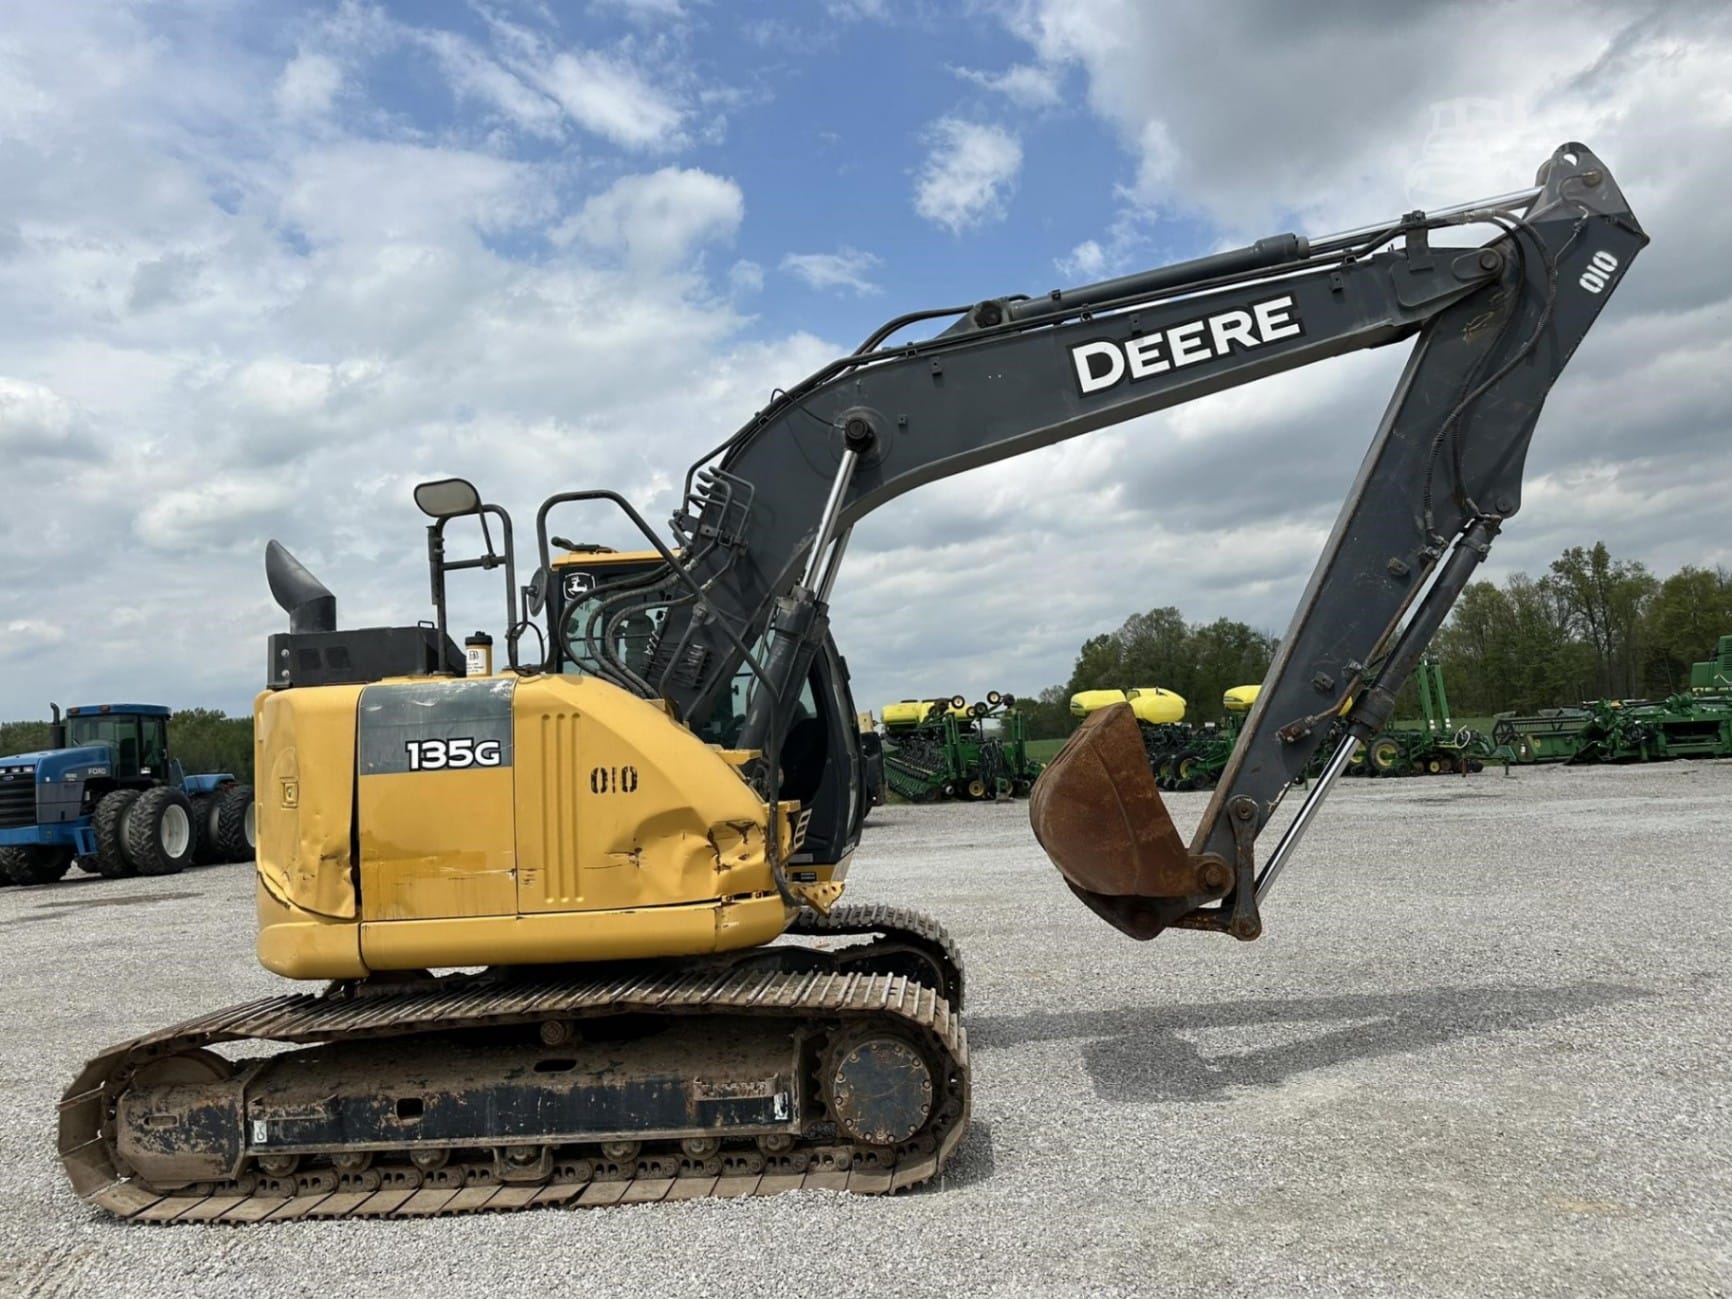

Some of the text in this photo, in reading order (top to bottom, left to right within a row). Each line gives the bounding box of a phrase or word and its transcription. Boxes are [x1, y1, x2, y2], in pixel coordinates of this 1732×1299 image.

[1579, 250, 1618, 294] 010
[1071, 295, 1301, 394] DEERE
[406, 738, 500, 771] 135G
[590, 766, 638, 794] 010
